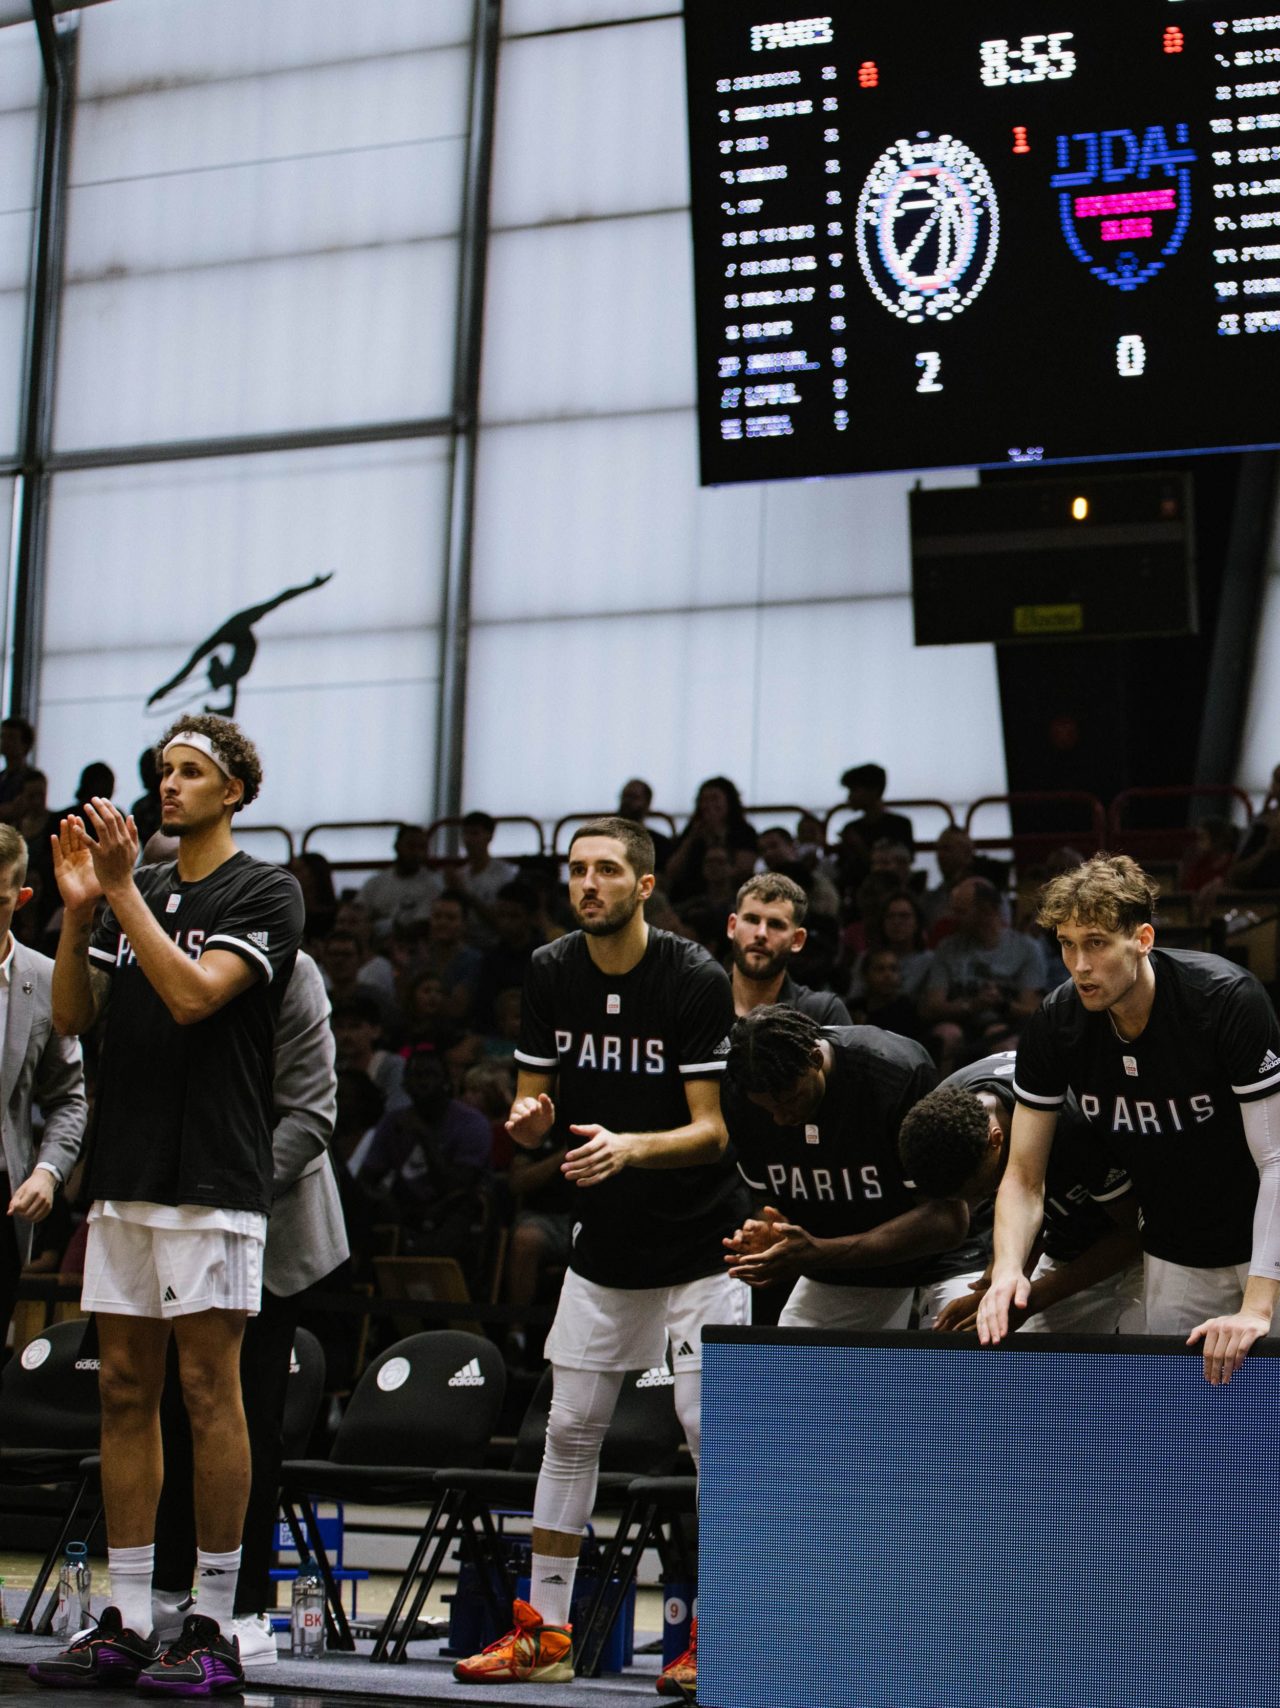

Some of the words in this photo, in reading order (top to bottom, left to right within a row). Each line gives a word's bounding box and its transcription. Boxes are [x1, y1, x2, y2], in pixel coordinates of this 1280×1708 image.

[980, 31, 1077, 87] 8:55
[1012, 126, 1031, 154] 1
[916, 351, 944, 393] 2
[1117, 334, 1147, 377] 0
[555, 1030, 664, 1073] PARIS
[1081, 1094, 1214, 1134] PARIS
[767, 1164, 883, 1201] PARIS
[448, 1375, 486, 1387] adidas
[636, 1375, 675, 1389] adidas
[304, 1613, 322, 1627] BK
[670, 1603, 679, 1619] 9
